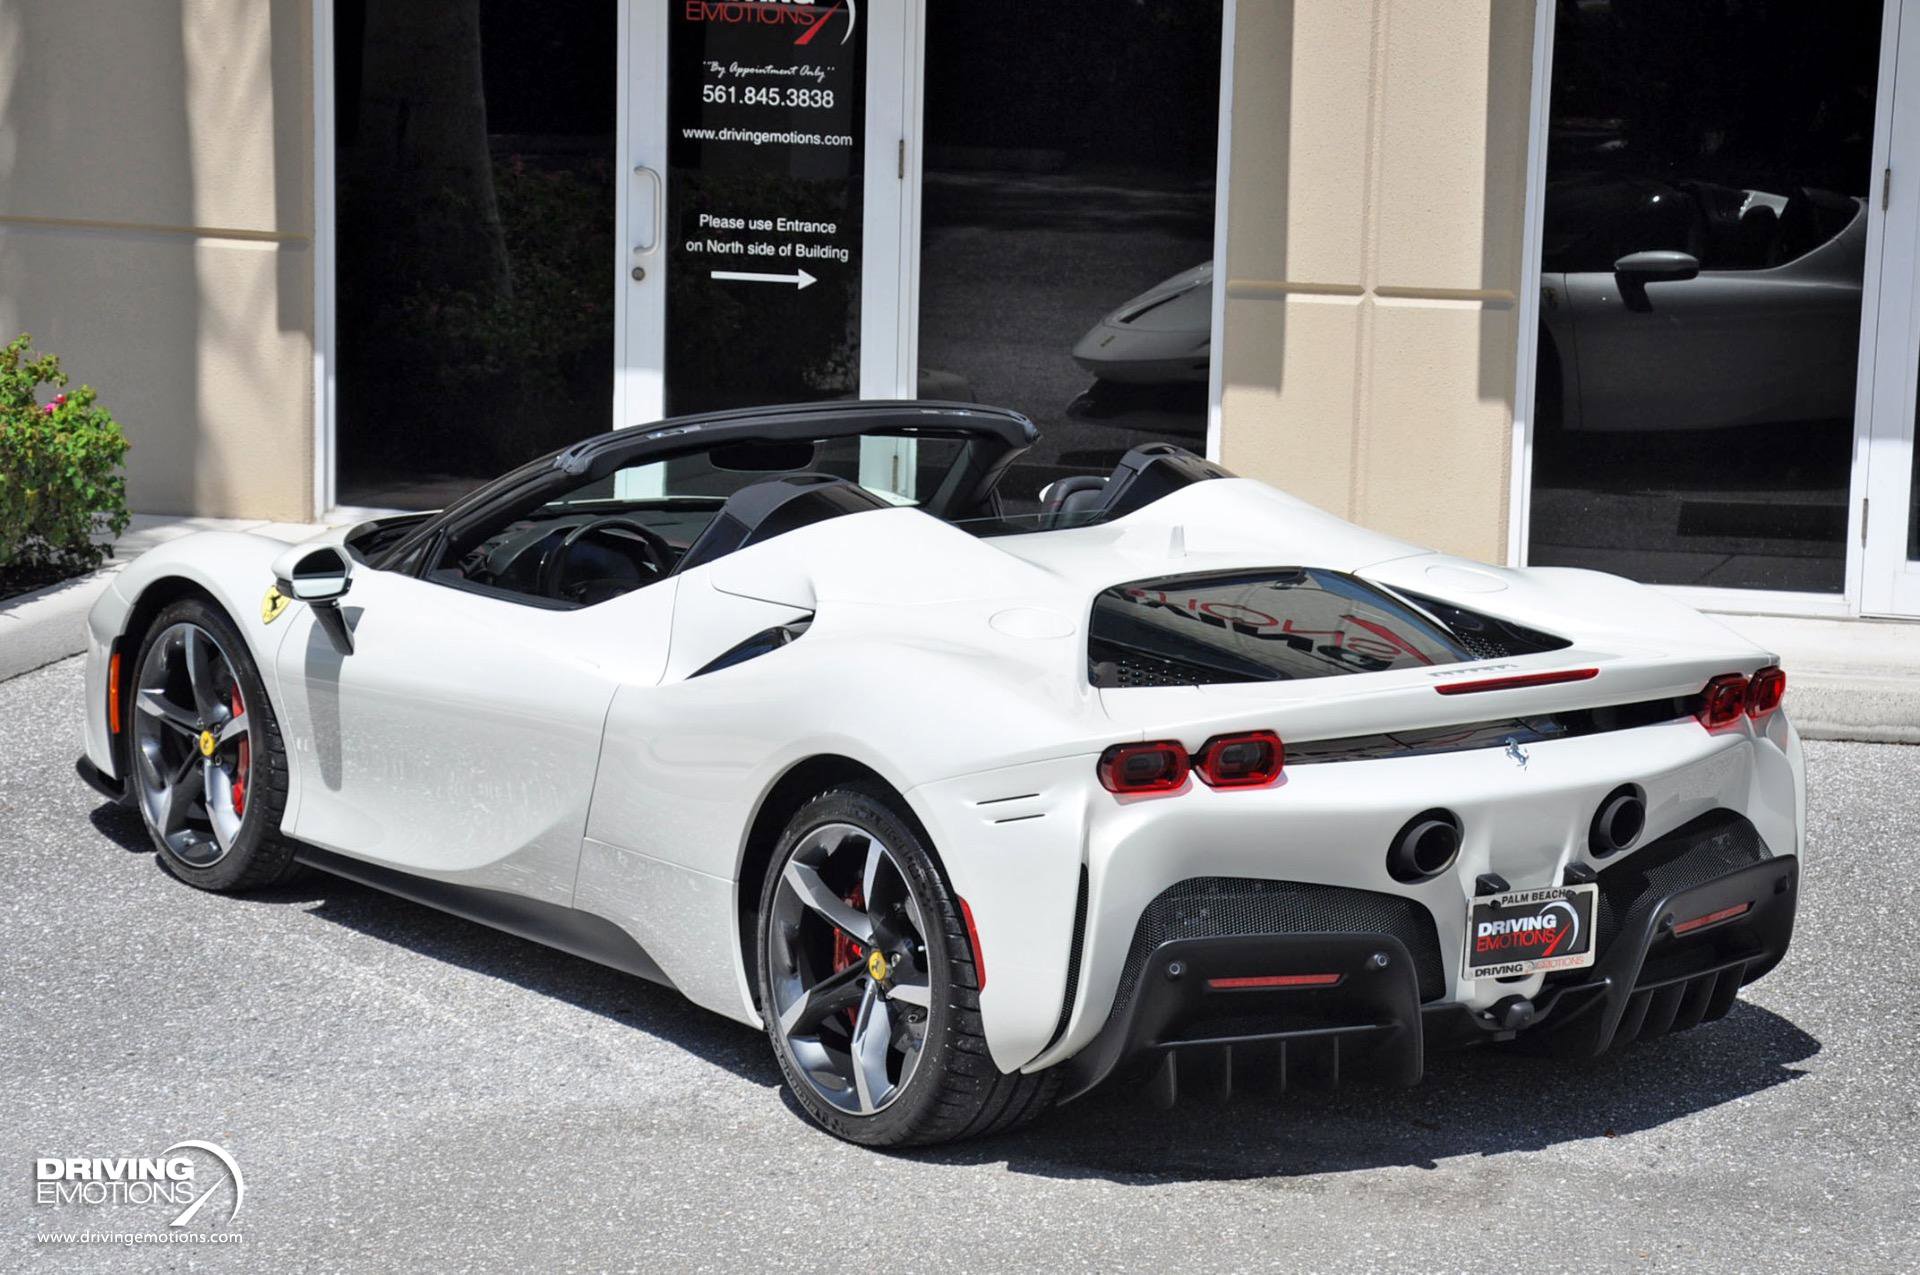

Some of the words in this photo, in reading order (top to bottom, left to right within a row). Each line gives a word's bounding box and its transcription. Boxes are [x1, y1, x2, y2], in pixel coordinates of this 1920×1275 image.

[686, 1, 816, 26] EMOTIONS
[729, 61, 799, 78] Appointment
[702, 84, 835, 109] 561.845.3838
[682, 127, 853, 146] www.drivingemotions.com
[699, 213, 745, 230] Please
[748, 219, 773, 231] use
[776, 217, 837, 234] Entrance
[685, 240, 703, 252] on
[706, 239, 744, 254] North
[747, 241, 775, 256] side
[778, 243, 793, 257] of
[795, 243, 849, 263] Building
[1501, 893, 1529, 905] PALM
[1531, 889, 1567, 901] BEACH
[1477, 914, 1557, 937] DRIVING
[1475, 928, 1557, 952] EMOTIONS
[1474, 963, 1523, 977] DRIVING
